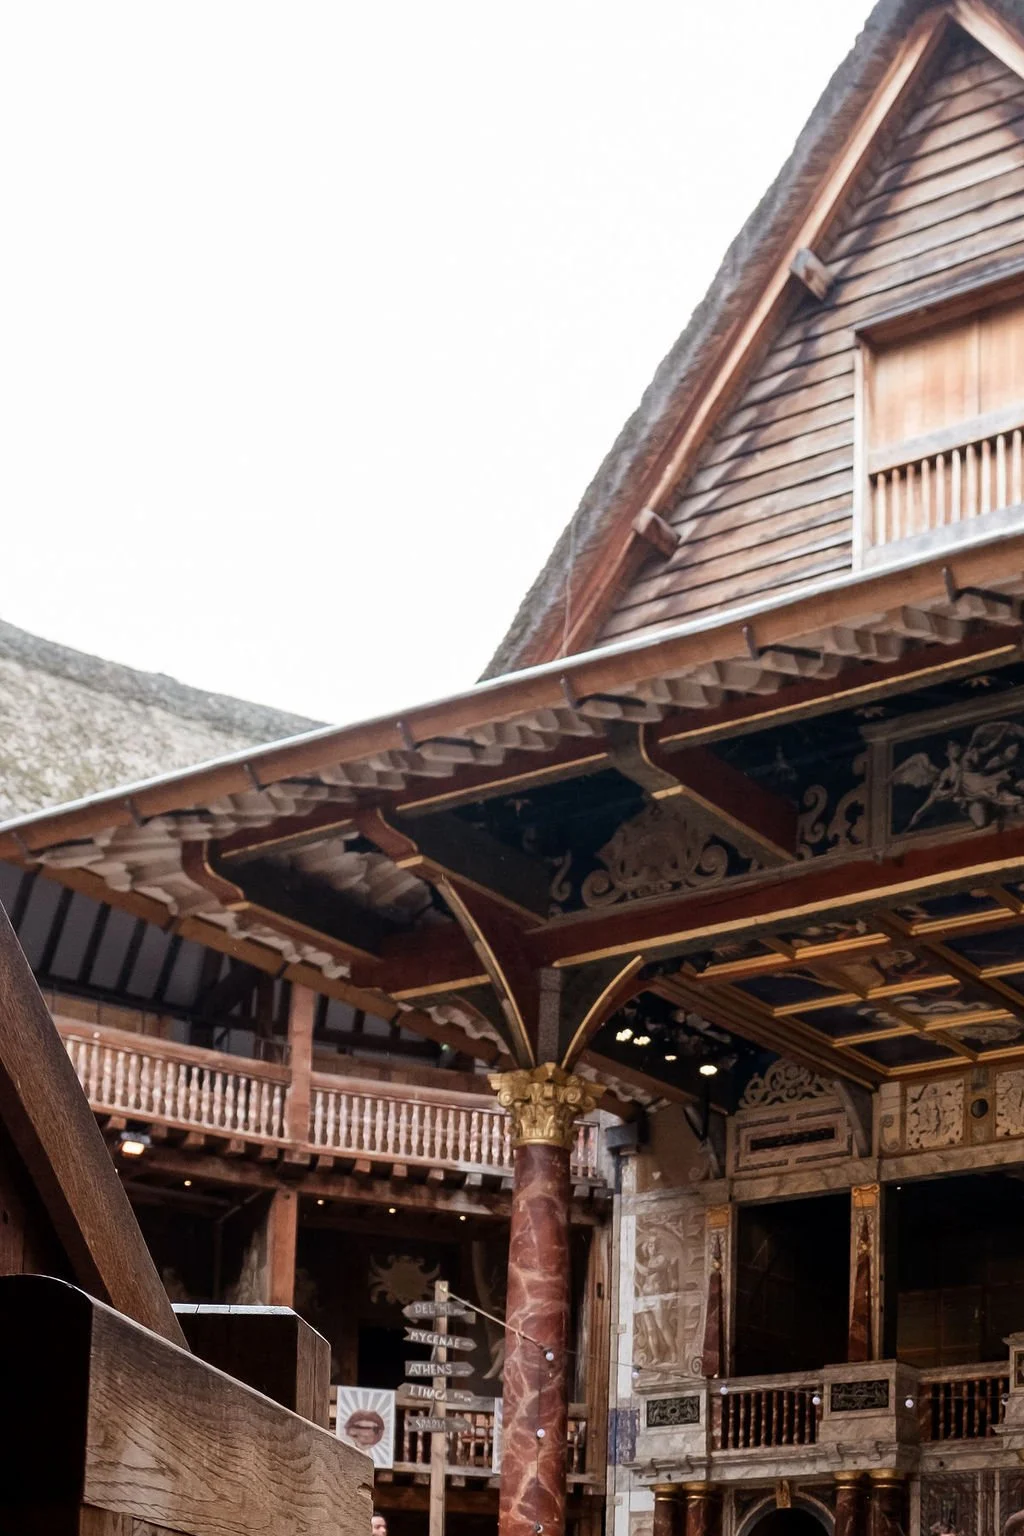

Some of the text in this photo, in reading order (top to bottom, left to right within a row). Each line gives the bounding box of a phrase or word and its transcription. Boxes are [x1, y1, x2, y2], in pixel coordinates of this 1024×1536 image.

[410, 1331, 460, 1349] MYCENAE
[408, 1363, 453, 1375] ATHENS
[409, 1385, 448, 1401] ITHACA
